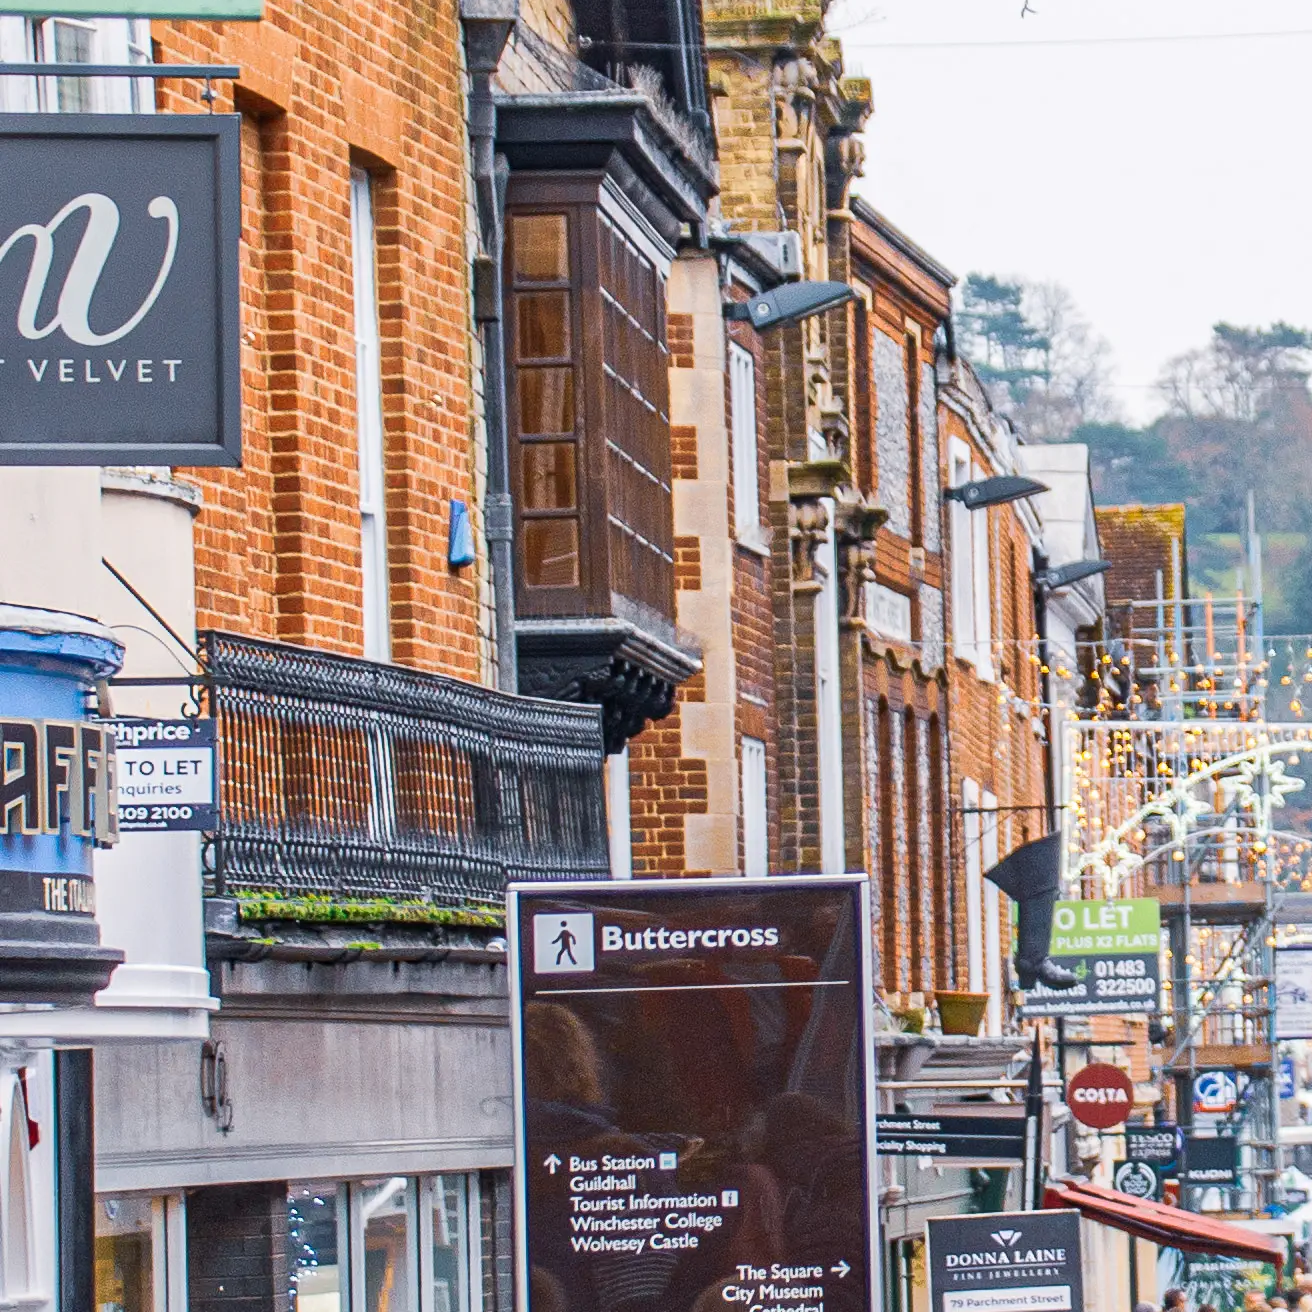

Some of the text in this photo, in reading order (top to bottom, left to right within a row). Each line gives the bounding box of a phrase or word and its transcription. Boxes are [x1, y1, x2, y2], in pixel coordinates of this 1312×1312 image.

[27, 359, 182, 382] VELVET
[125, 759, 202, 776] TO LET
[117, 781, 182, 797] nquiries
[150, 806, 193, 820] 2100
[1055, 904, 1133, 931] O LET
[601, 924, 779, 952] Buttercross
[1056, 936, 1093, 950] PLUS
[1116, 933, 1158, 948] FLATS
[1094, 959, 1146, 978] 01483
[1095, 977, 1156, 997] 322500
[1073, 1087, 1129, 1104] COSTA
[912, 1119, 941, 1130] Street
[905, 1140, 947, 1154] Shopping
[569, 1154, 655, 1172] Bus Station
[569, 1174, 637, 1192] Guildhall
[569, 1192, 718, 1212] Tourist Information
[569, 1212, 723, 1232] Winchester College
[571, 1232, 699, 1255] Wolvesey Castle
[945, 1248, 1067, 1268] DONNA LAINE
[735, 1263, 824, 1283] The Square
[953, 1268, 1061, 1281] FINE JEWELLERY
[721, 1284, 824, 1305] City Museum
[951, 1293, 1065, 1309] 79 Parchment Street
